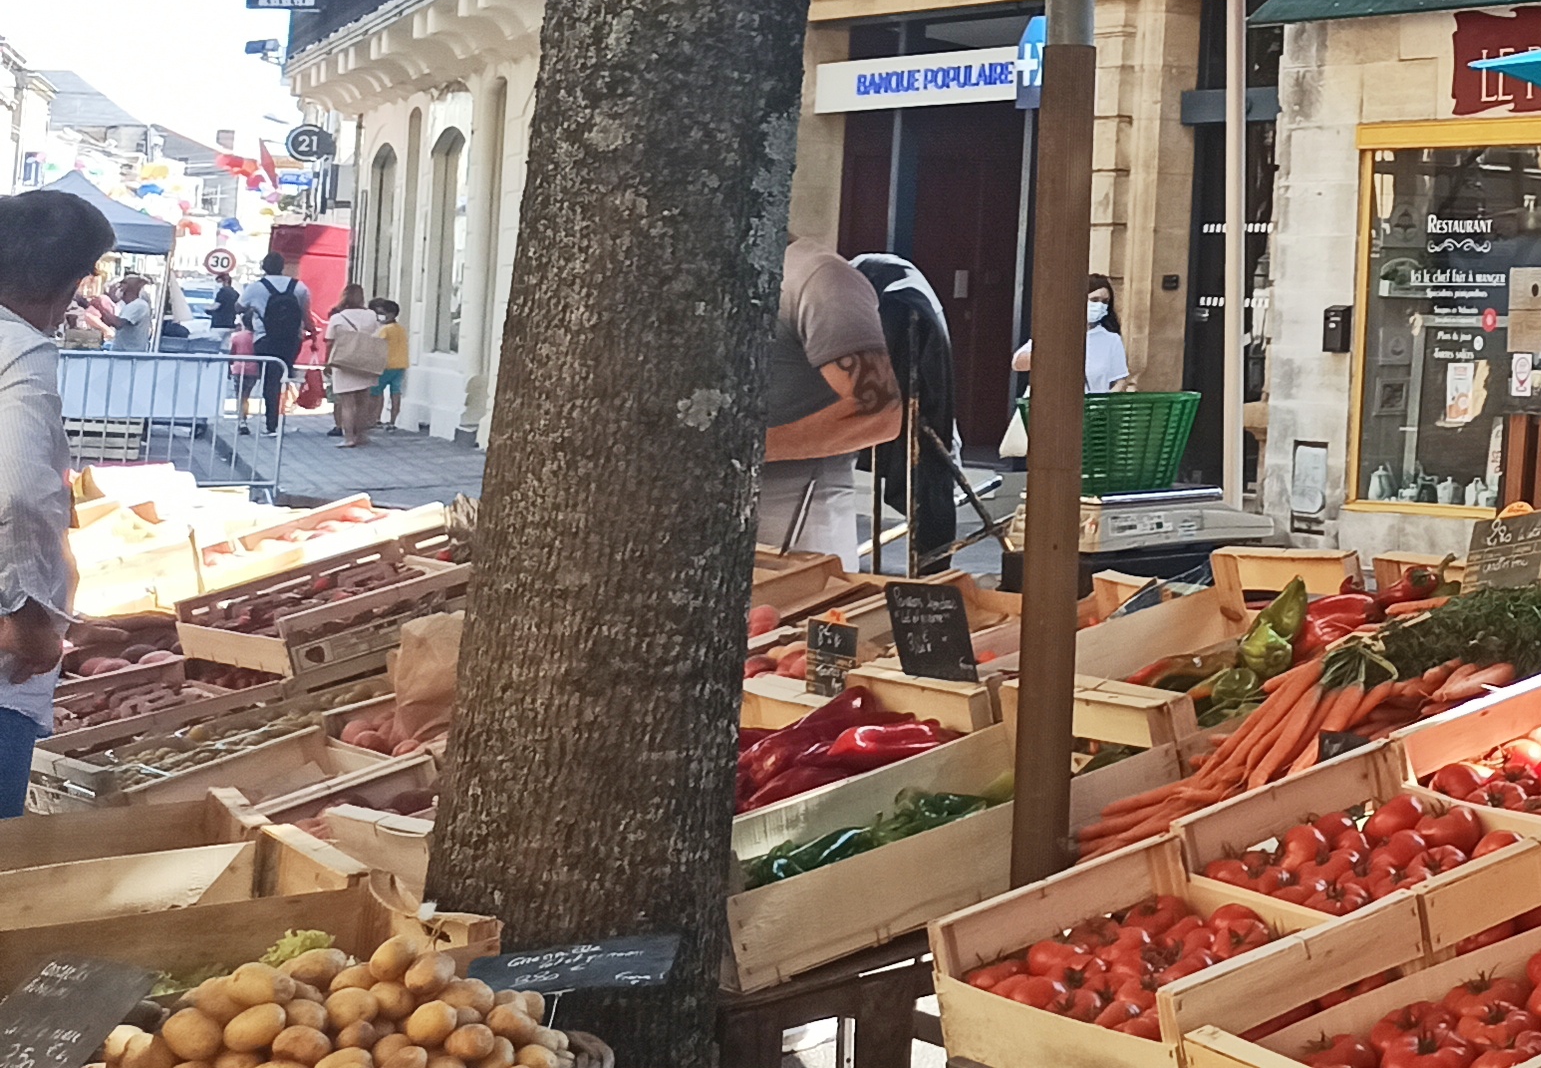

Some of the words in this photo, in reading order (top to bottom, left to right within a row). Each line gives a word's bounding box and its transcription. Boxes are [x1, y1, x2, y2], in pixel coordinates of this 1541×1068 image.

[856, 69, 921, 96] BANQUE
[923, 61, 1015, 90] POPULAIRE
[298, 135, 318, 151] 21
[210, 256, 231, 268] 30
